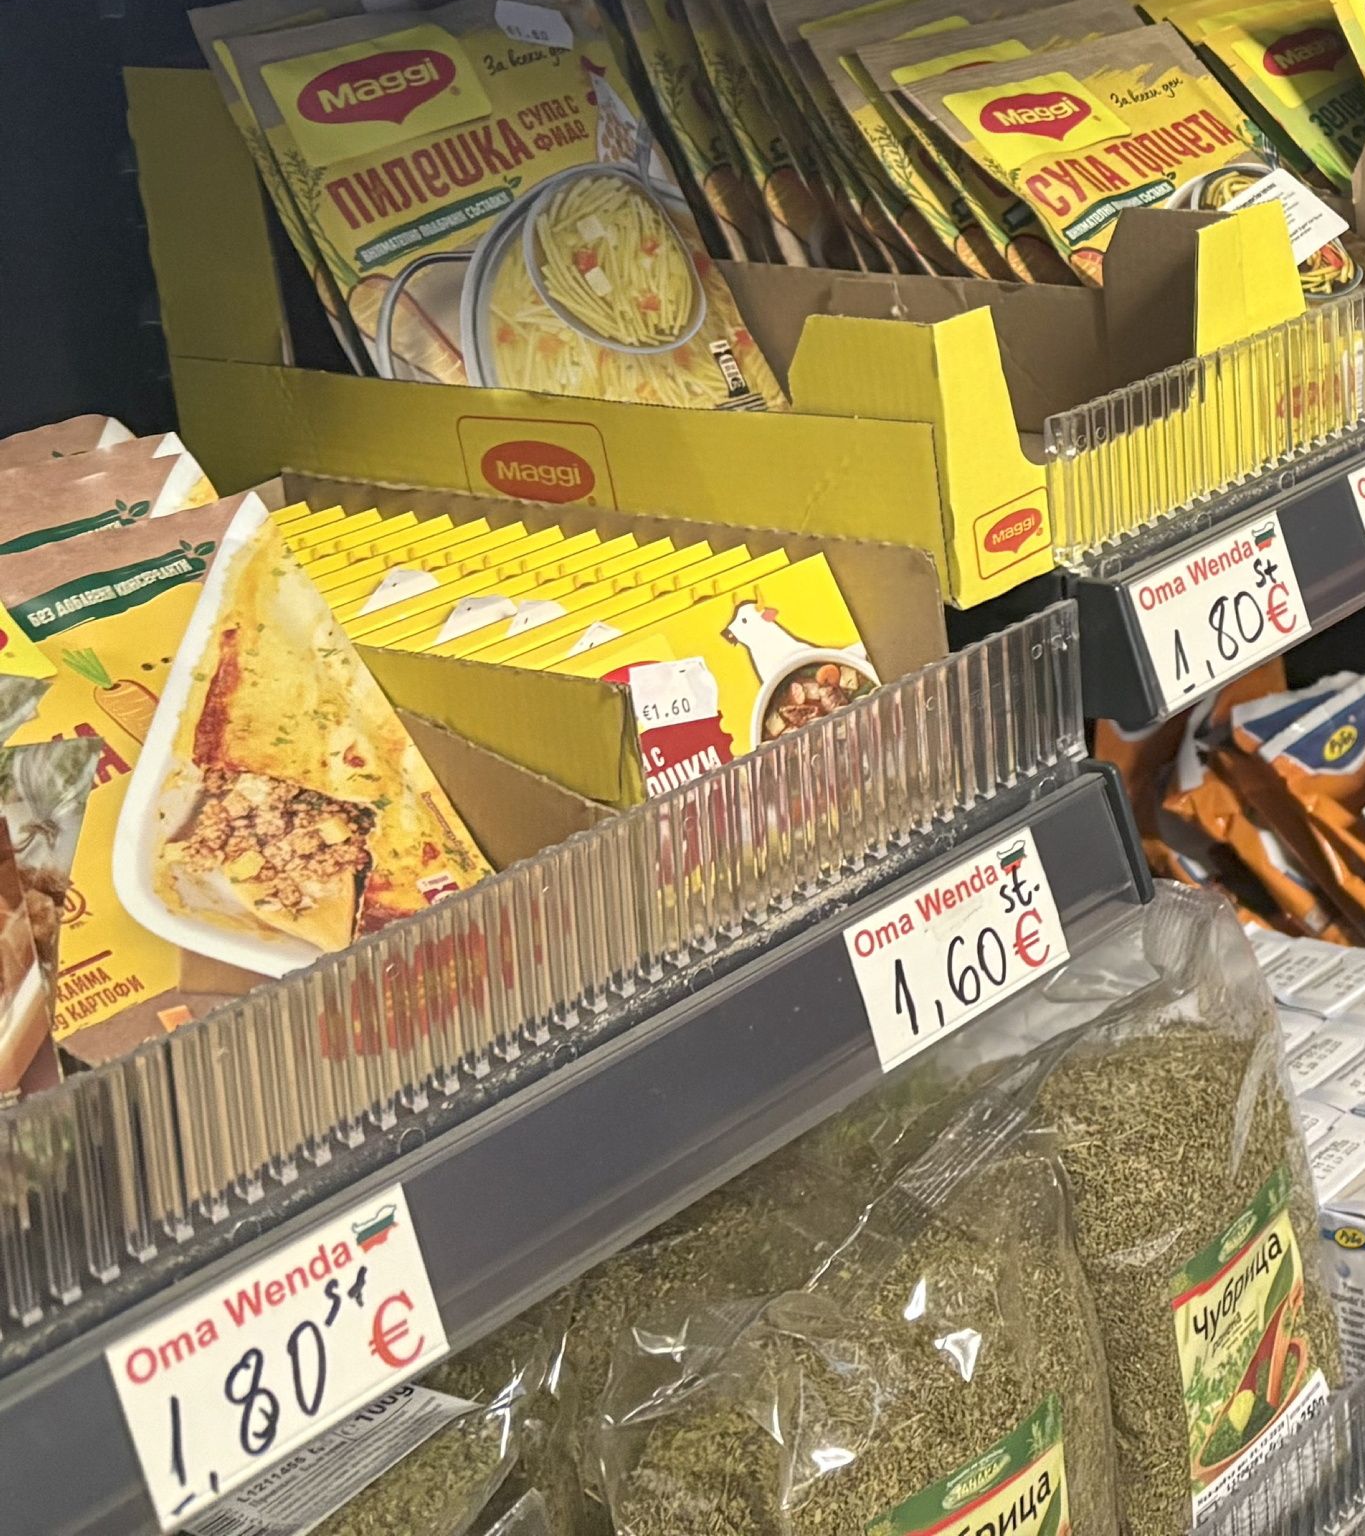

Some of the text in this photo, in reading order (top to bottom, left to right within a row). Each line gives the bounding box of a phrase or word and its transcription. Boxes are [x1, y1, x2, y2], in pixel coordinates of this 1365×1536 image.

[317, 57, 440, 114] Maggi
[993, 96, 1081, 128] Maggi
[1025, 153, 1130, 218] СУПА
[495, 458, 583, 488] Maggi
[991, 514, 1037, 548] Maggi
[1139, 540, 1254, 612] Oma Wenda
[1174, 590, 1265, 694] 1,80
[1266, 581, 1297, 634] €
[642, 697, 691, 721] €1.60
[854, 864, 1000, 958] Oma Wenda
[70, 973, 146, 1031] КАРТОФИ
[894, 927, 1007, 1036] 1,60
[1012, 908, 1050, 968] €
[126, 1240, 353, 1384] Oma Wenda
[1192, 1230, 1284, 1343] Чубрица
[170, 1320, 328, 1517] 1,80
[369, 1290, 425, 1369] €
